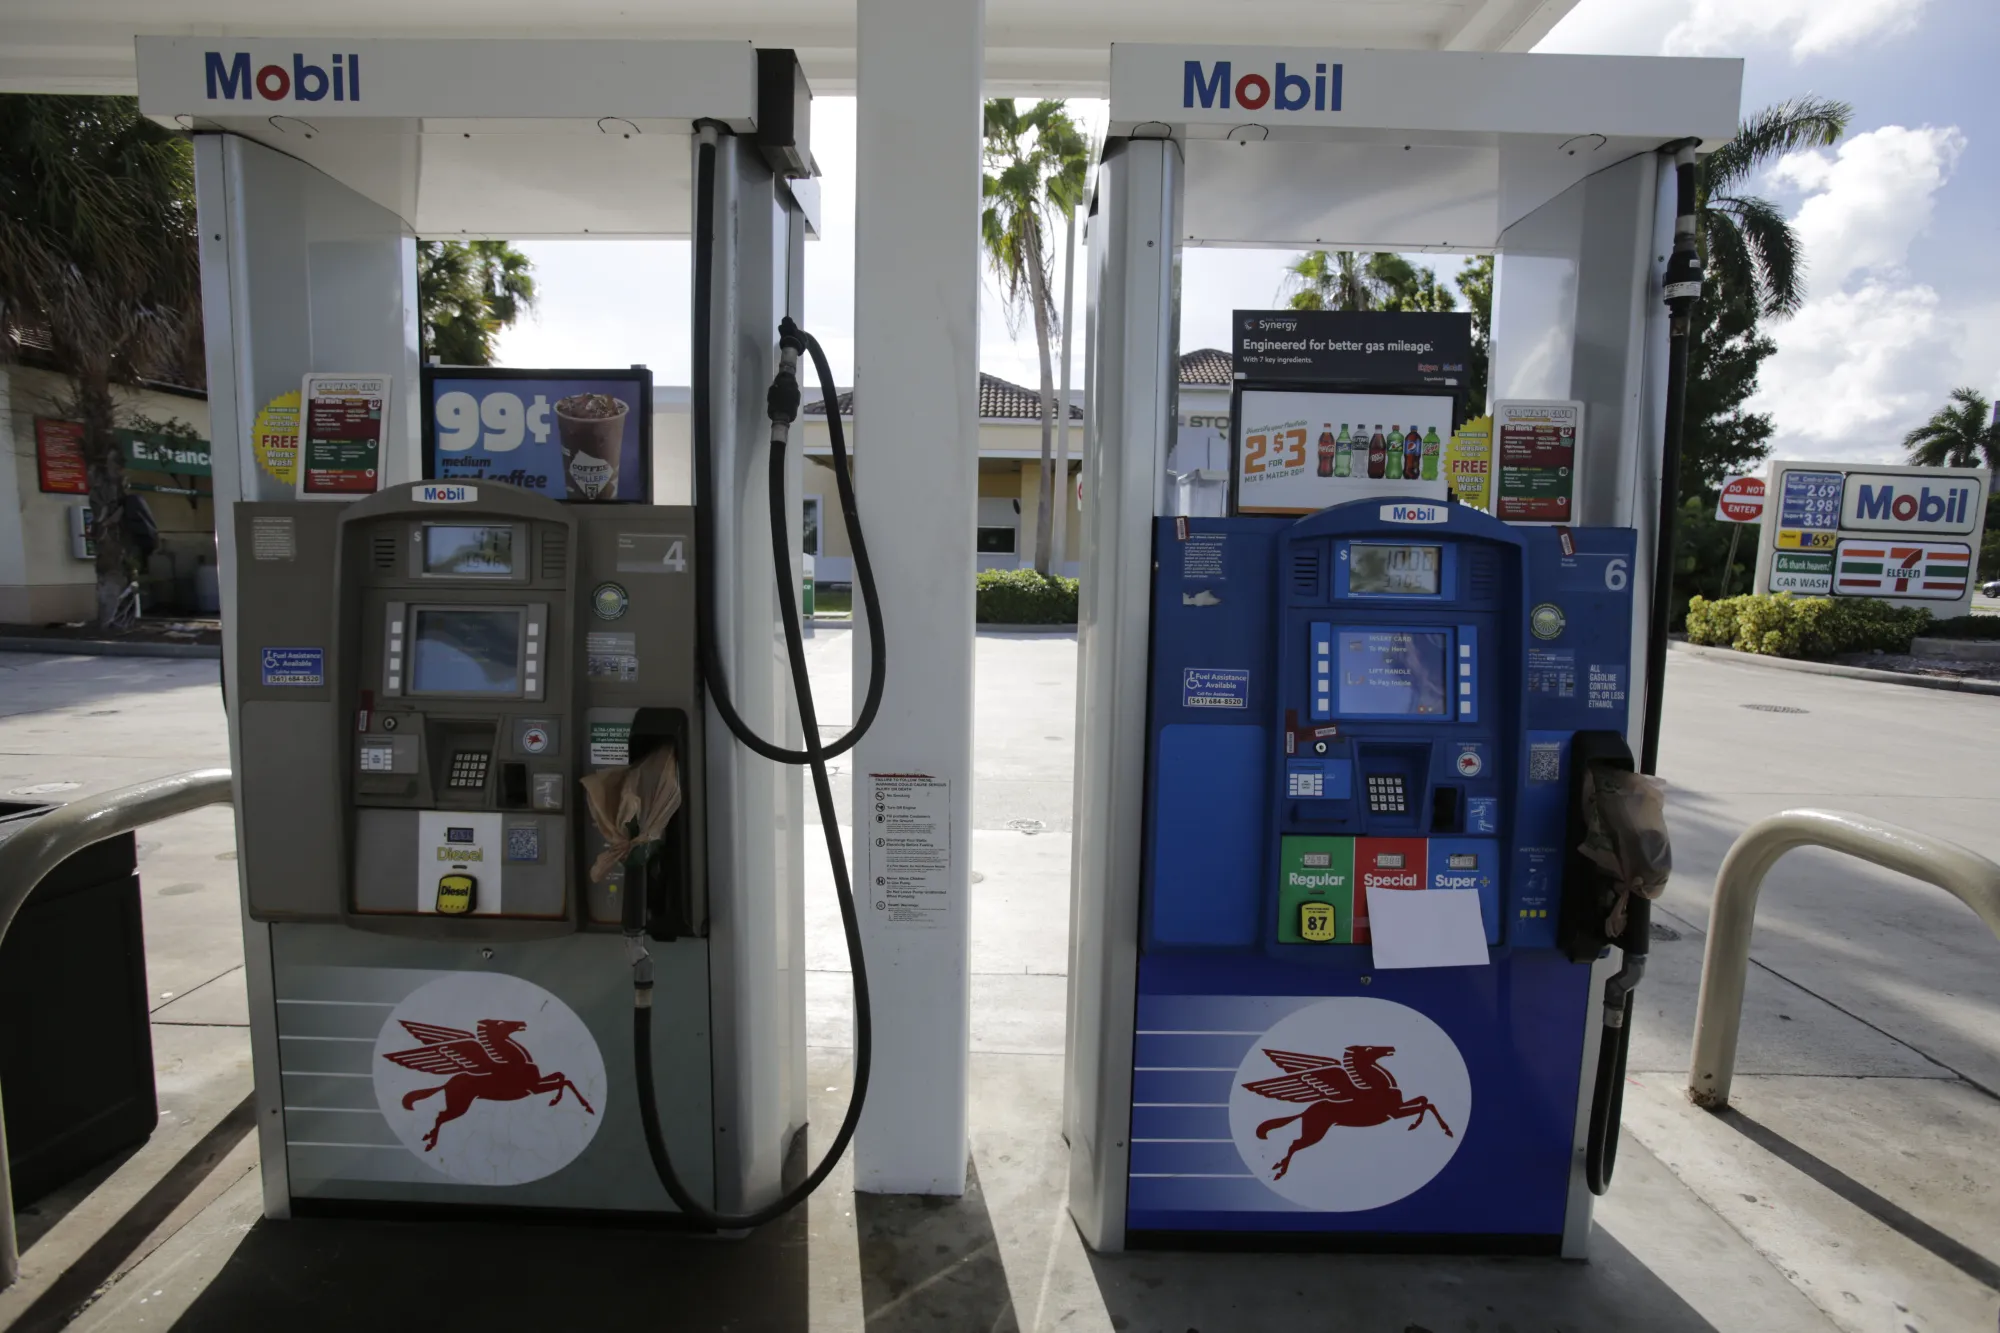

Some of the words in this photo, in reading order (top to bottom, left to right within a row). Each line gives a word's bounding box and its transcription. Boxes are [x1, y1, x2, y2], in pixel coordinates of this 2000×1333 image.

[205, 51, 361, 101] Mobil
[1183, 60, 1343, 111] Mobil
[1259, 320, 1297, 332] Synergy
[1243, 338, 1307, 353] Engineered
[1309, 339, 1325, 351] for
[1328, 339, 1363, 351] better
[1365, 342, 1385, 354] gas
[1265, 356, 1276, 365] key
[1505, 409, 1522, 417] CAR
[1523, 409, 1549, 418] WASH
[1550, 410, 1572, 419] CLUB
[262, 435, 298, 448] FREE
[266, 450, 295, 459] Works
[1244, 435, 1267, 475] 2
[268, 458, 292, 467] Wash
[442, 455, 492, 468] medium
[1268, 458, 1283, 468] FOR
[1452, 460, 1488, 474] FREE
[1456, 475, 1484, 484] Works
[424, 487, 465, 500] Mobil
[1458, 484, 1482, 492] Wash
[1729, 484, 1742, 494] DO
[1746, 485, 1764, 496] NOT
[1728, 503, 1757, 515] ENTER
[1856, 484, 1968, 524] Mobil
[1393, 507, 1435, 521] Mobil
[414, 531, 421, 542] $
[663, 540, 687, 572] 4
[1340, 549, 1348, 561] $
[1789, 559, 1806, 570] thank
[1604, 558, 1628, 591] 6
[1777, 577, 1797, 587] CAR
[1800, 577, 1829, 589] WASH
[1590, 664, 1600, 672] ALL
[1195, 673, 1210, 681] Fuel
[1211, 674, 1247, 682] Assistance
[1589, 673, 1617, 682] GASOLINE
[1205, 681, 1237, 690] Available
[1589, 682, 1617, 691] CONTAINS
[1189, 697, 1207, 706] (561)
[1209, 698, 1242, 706] 684-8520
[1602, 692, 1610, 700] OR
[1610, 692, 1625, 700] LESS
[1588, 700, 1614, 709] ETHANOL
[436, 847, 484, 862] Diesel
[1288, 872, 1345, 888] Regular
[1363, 873, 1417, 889] Special
[1435, 874, 1476, 889] Super
[440, 885, 471, 897] Diesel
[1307, 916, 1328, 931] 87
